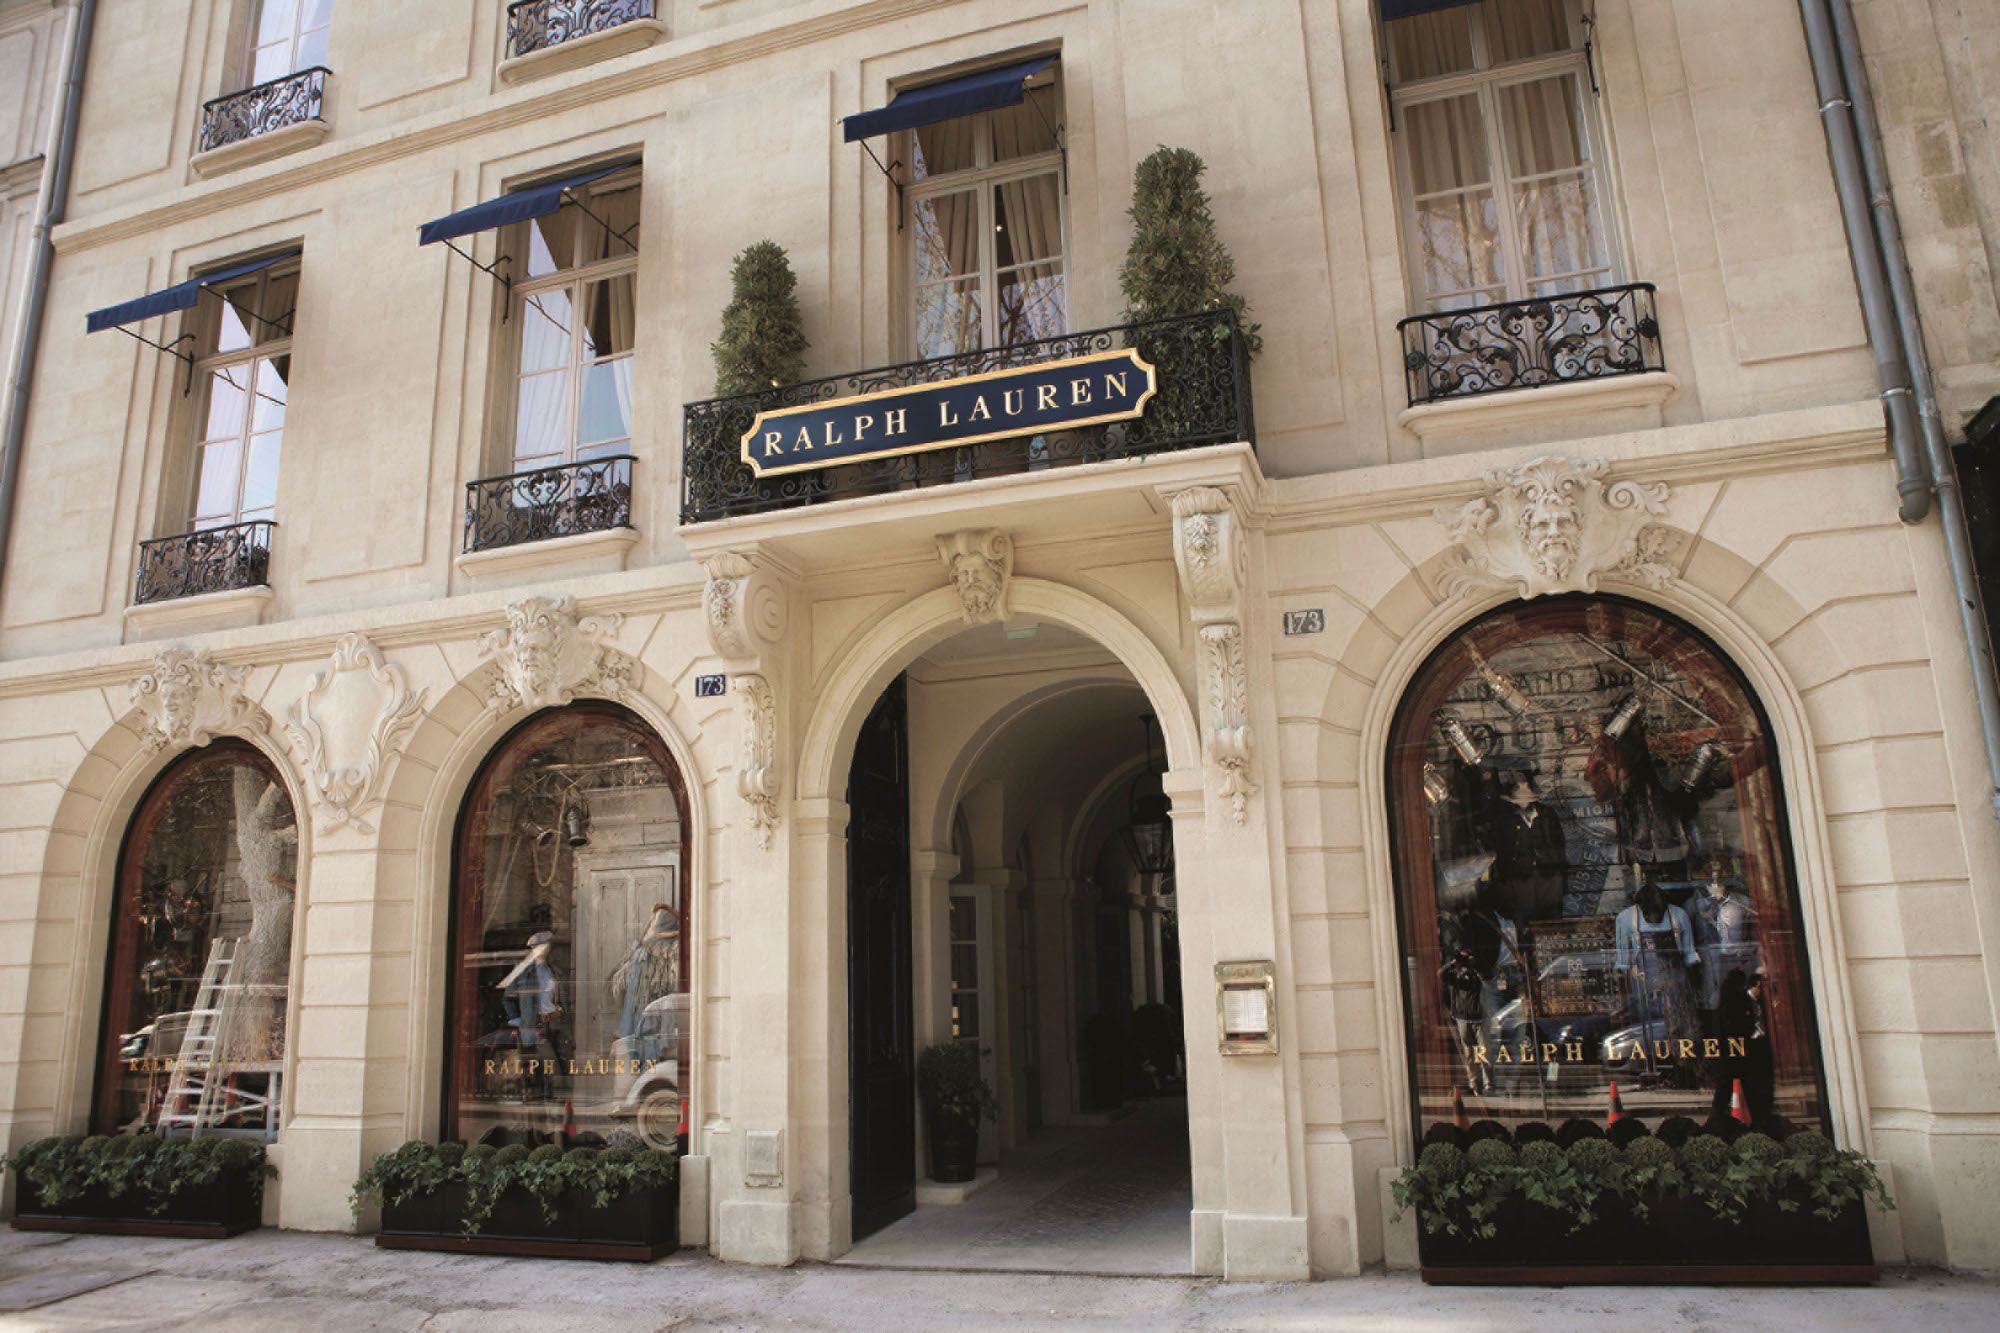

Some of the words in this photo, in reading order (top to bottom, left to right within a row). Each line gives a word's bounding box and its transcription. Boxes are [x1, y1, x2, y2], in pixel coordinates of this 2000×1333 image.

[764, 408, 907, 457] RALPH
[938, 371, 1128, 428] LAUREN
[1287, 611, 1321, 634] 173
[698, 675, 724, 696] 173
[1473, 1042, 1584, 1064] RALPH
[1607, 1037, 1746, 1061] LAUREN
[129, 1058, 188, 1072] RALPH
[485, 1059, 556, 1075] RALPH
[568, 1059, 657, 1075] LAUREN
